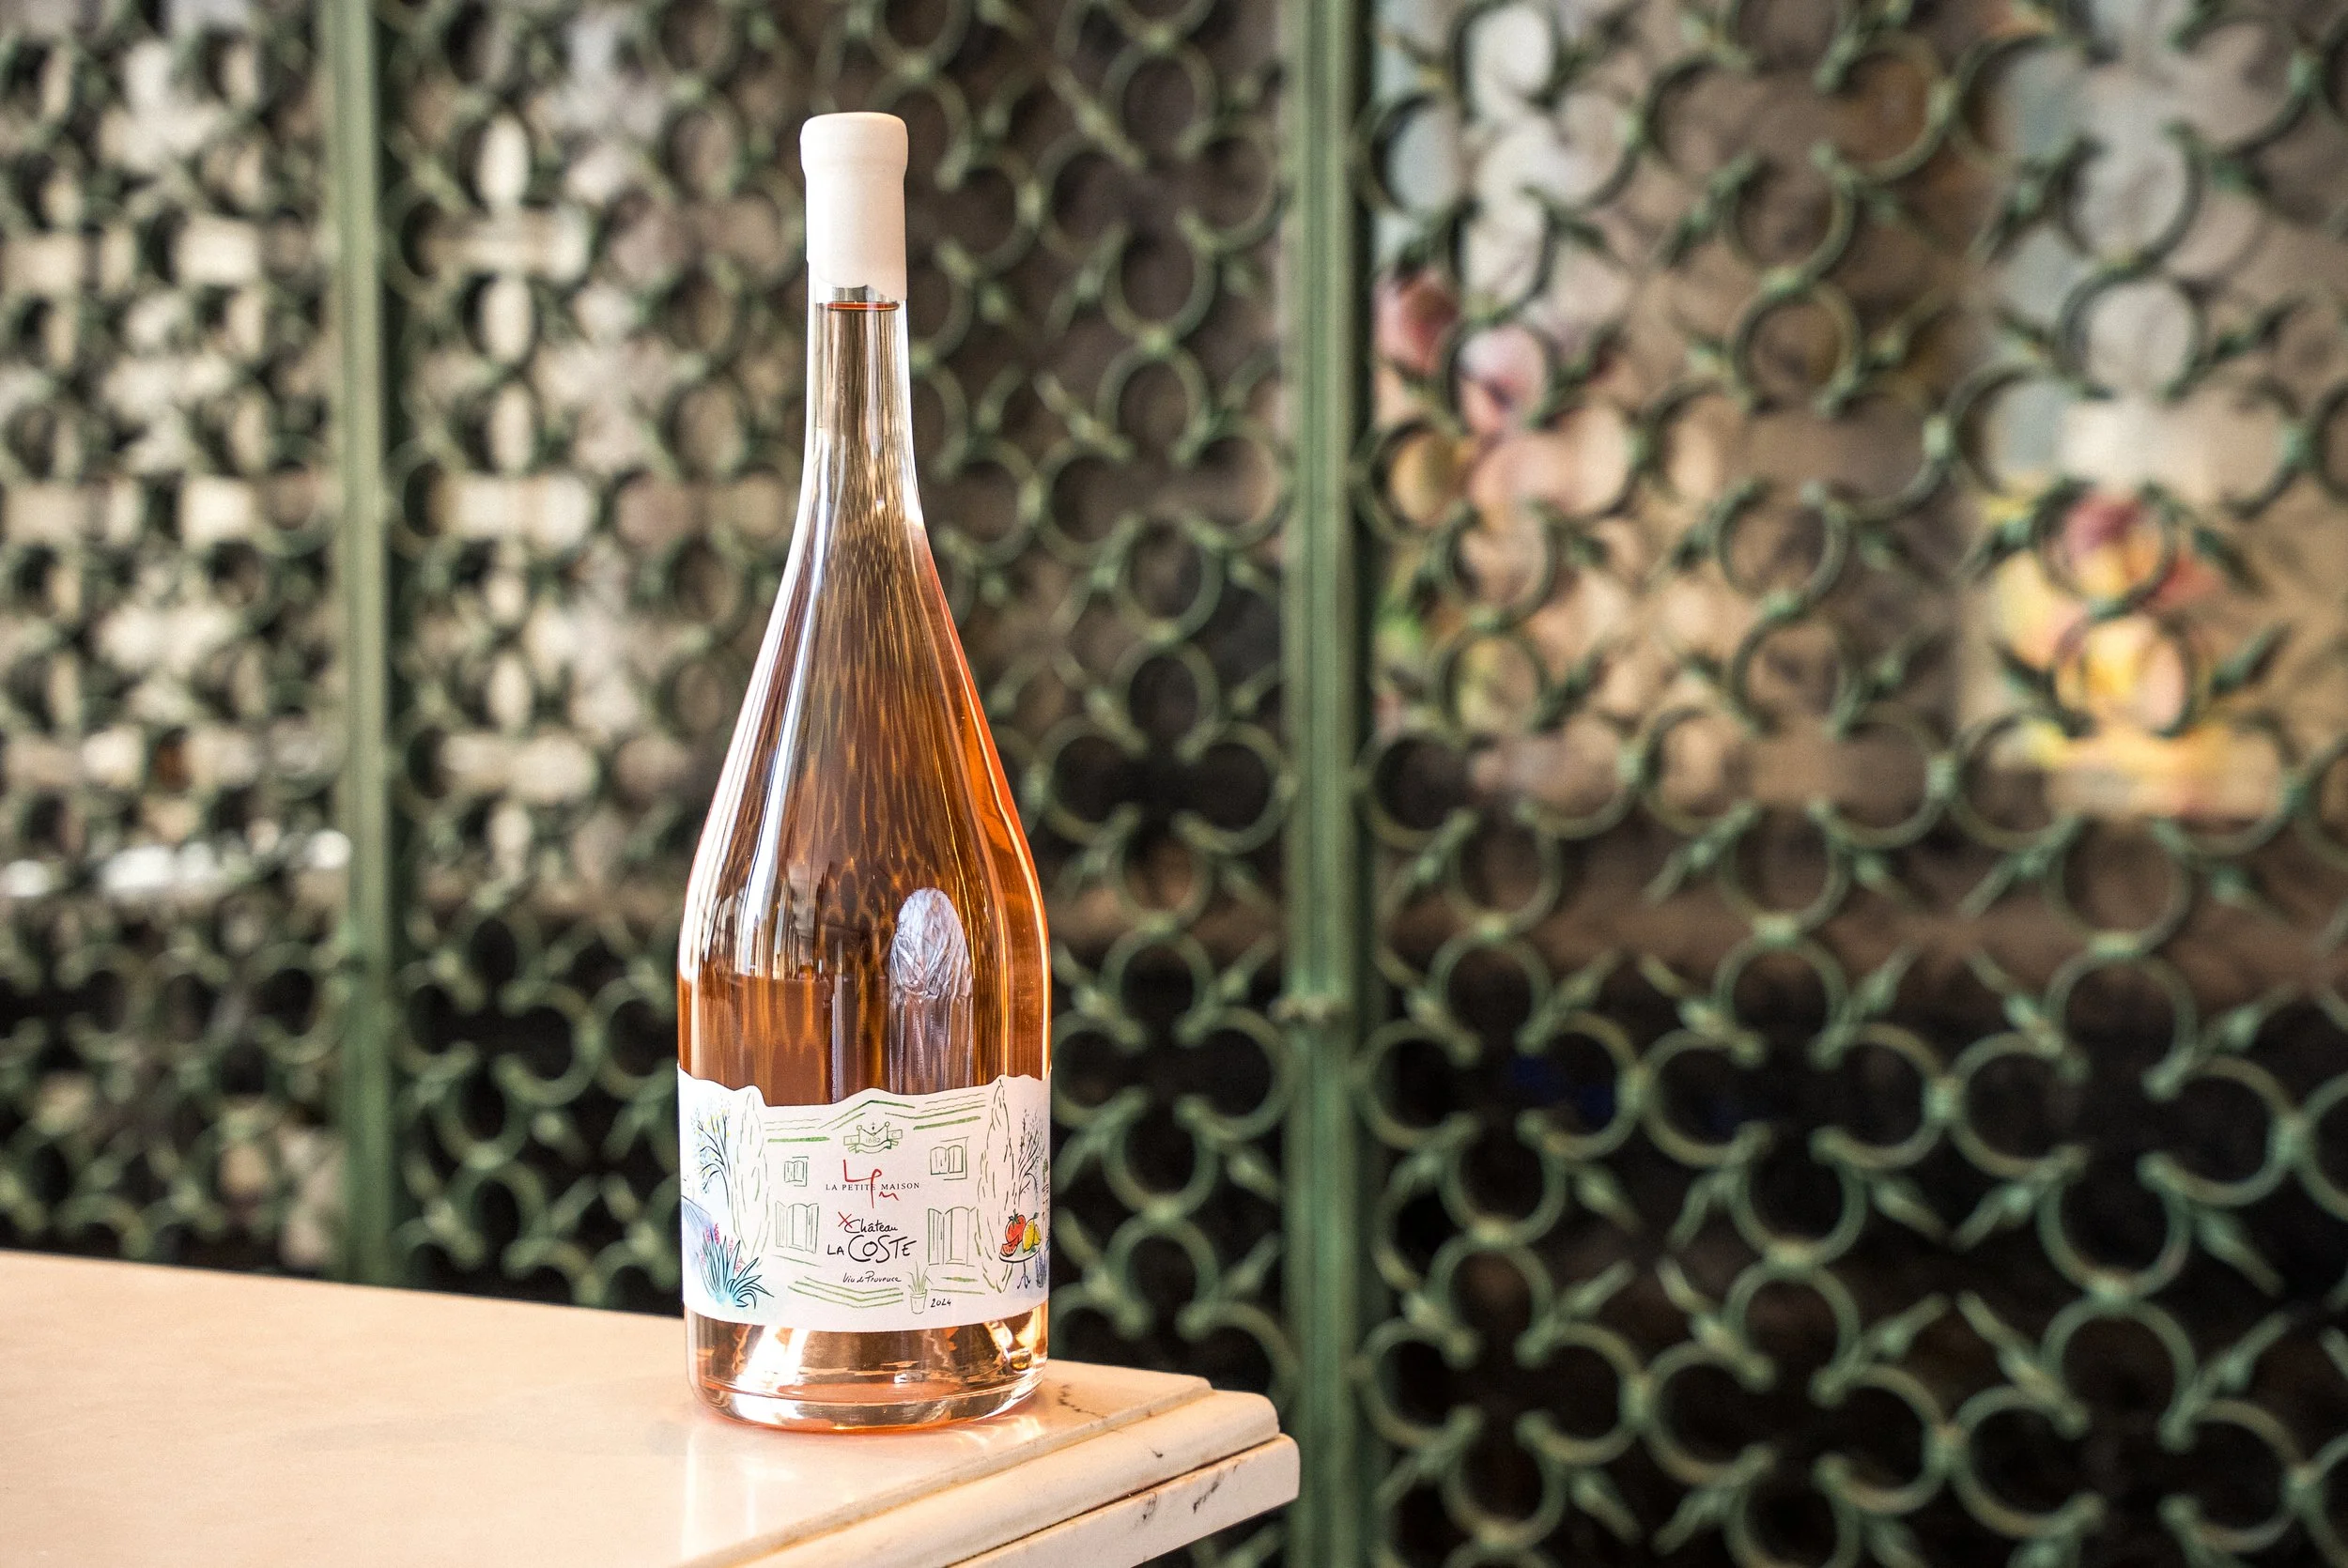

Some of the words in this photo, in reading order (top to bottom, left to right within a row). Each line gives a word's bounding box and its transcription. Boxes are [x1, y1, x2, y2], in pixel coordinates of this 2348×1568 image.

[842, 1183, 876, 1191] PETITE
[881, 1182, 920, 1191] MAISON
[843, 1218, 899, 1234] Château
[826, 1244, 844, 1256] LA
[847, 1235, 918, 1264] COSTE
[842, 1272, 856, 1284] Vin
[865, 1270, 903, 1284] Provence
[930, 1298, 952, 1308] 2024
